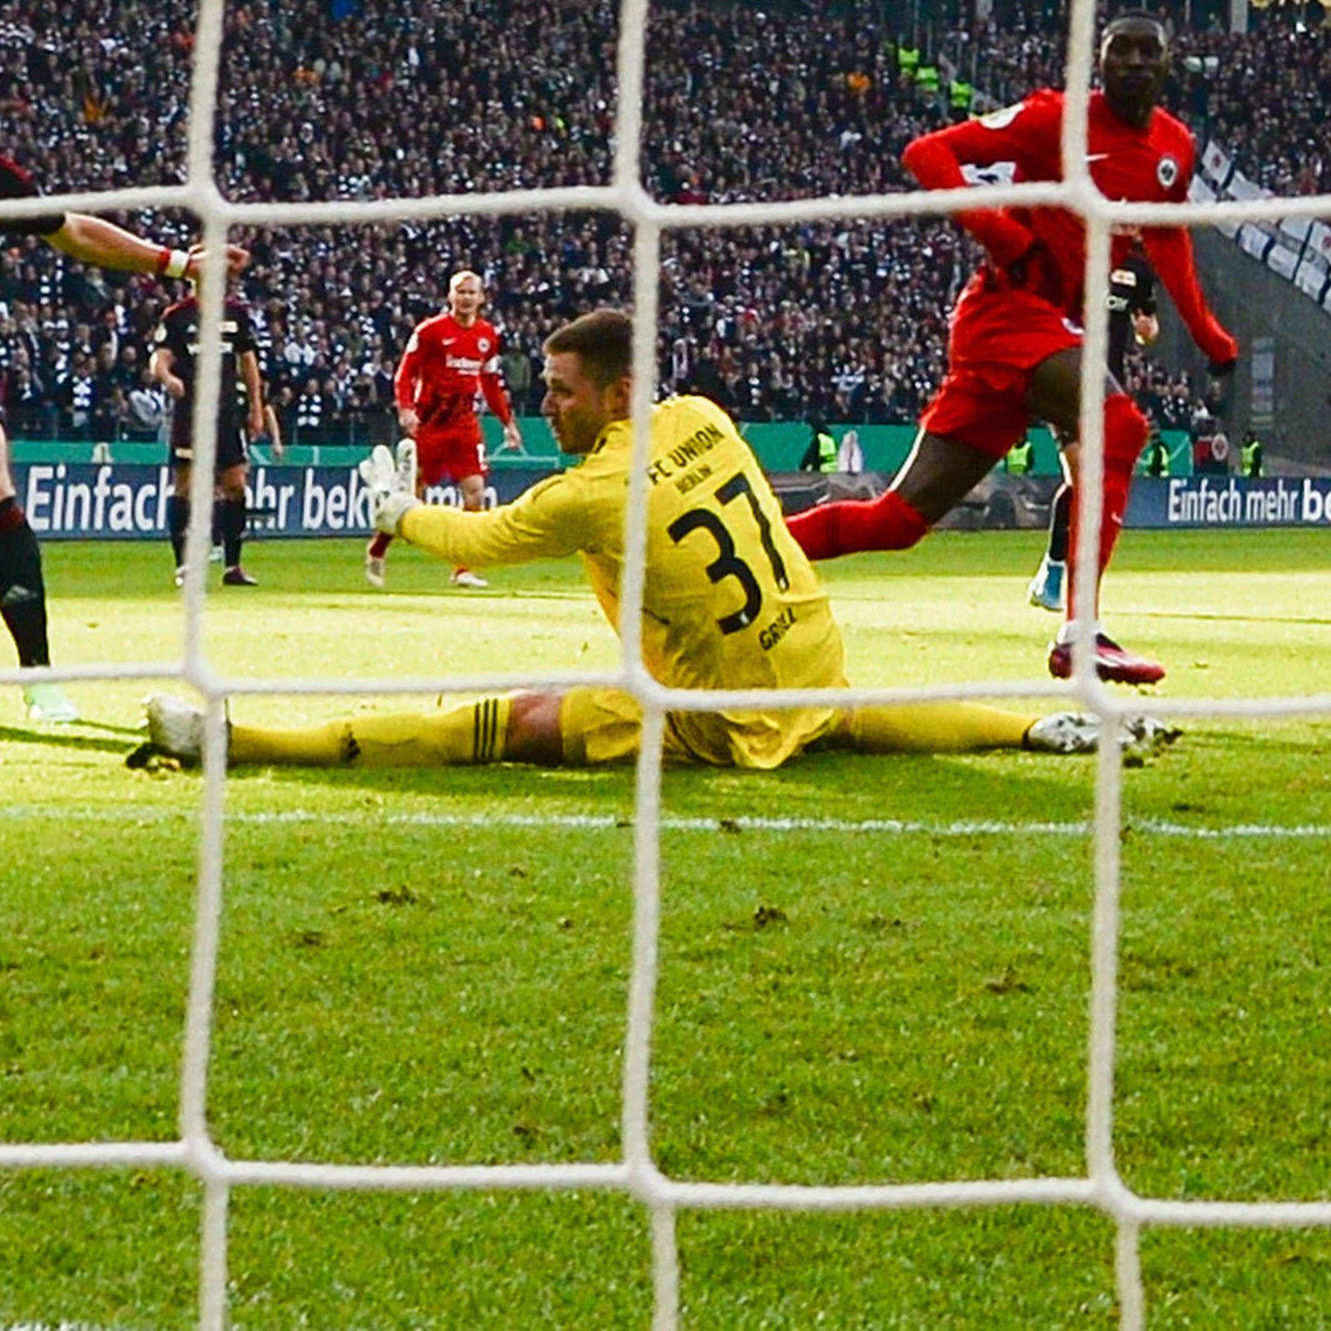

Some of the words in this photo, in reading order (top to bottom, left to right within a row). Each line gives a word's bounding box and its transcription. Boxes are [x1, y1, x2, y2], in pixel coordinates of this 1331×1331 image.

[646, 459, 673, 486] FC
[666, 423, 725, 468] UNION
[26, 465, 175, 532] Einfach
[1168, 477, 1241, 522] Einfach
[1246, 477, 1299, 522] mehr
[667, 472, 790, 635] 37
